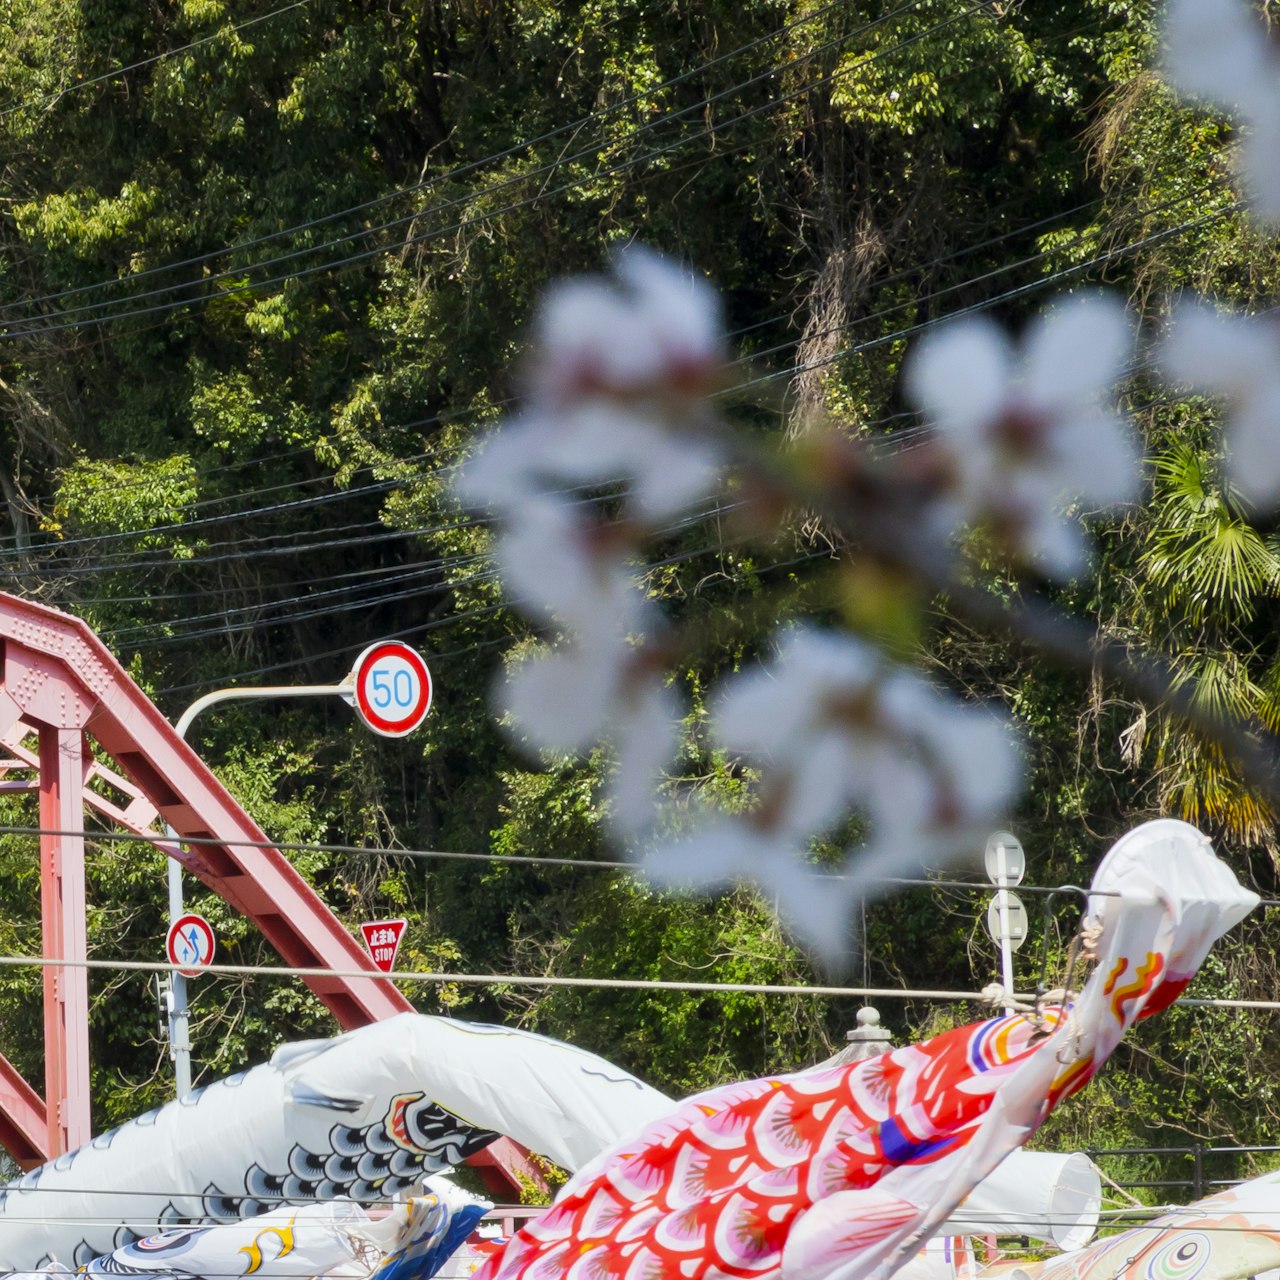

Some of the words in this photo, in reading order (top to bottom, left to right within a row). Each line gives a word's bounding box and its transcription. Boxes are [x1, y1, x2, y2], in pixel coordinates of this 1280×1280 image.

[372, 669, 413, 708] 50
[370, 928, 396, 946] 止まれ
[375, 947, 393, 962] STOP
